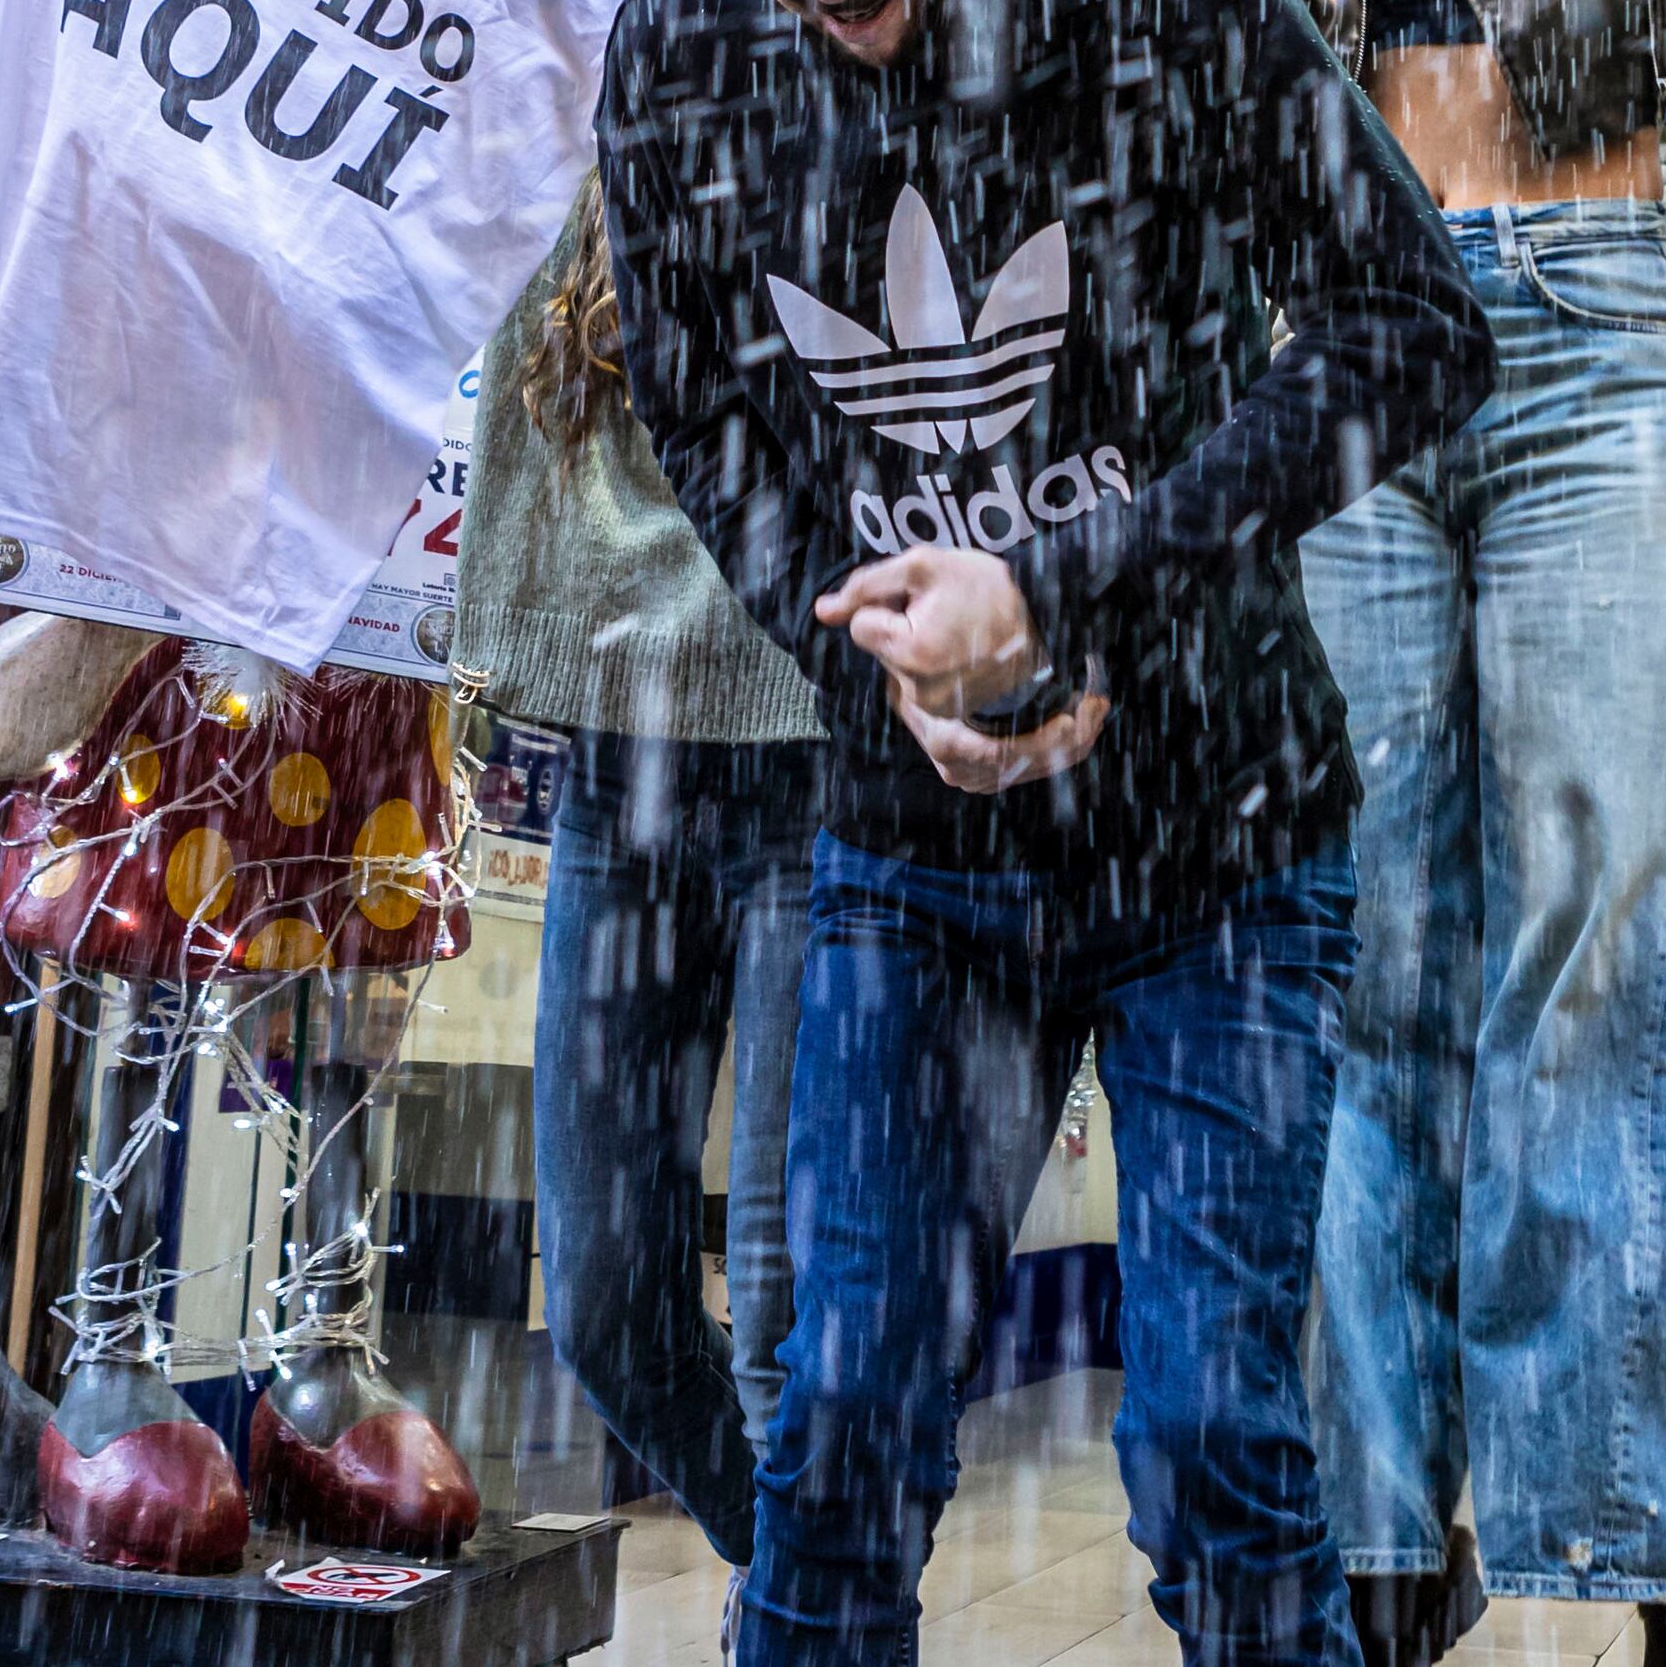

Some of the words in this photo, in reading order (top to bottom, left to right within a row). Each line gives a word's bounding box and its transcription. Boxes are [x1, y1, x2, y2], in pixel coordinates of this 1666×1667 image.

[850, 445, 1132, 556] adidas
[59, 564, 74, 575] 22
[422, 591, 454, 604] SUERTE
